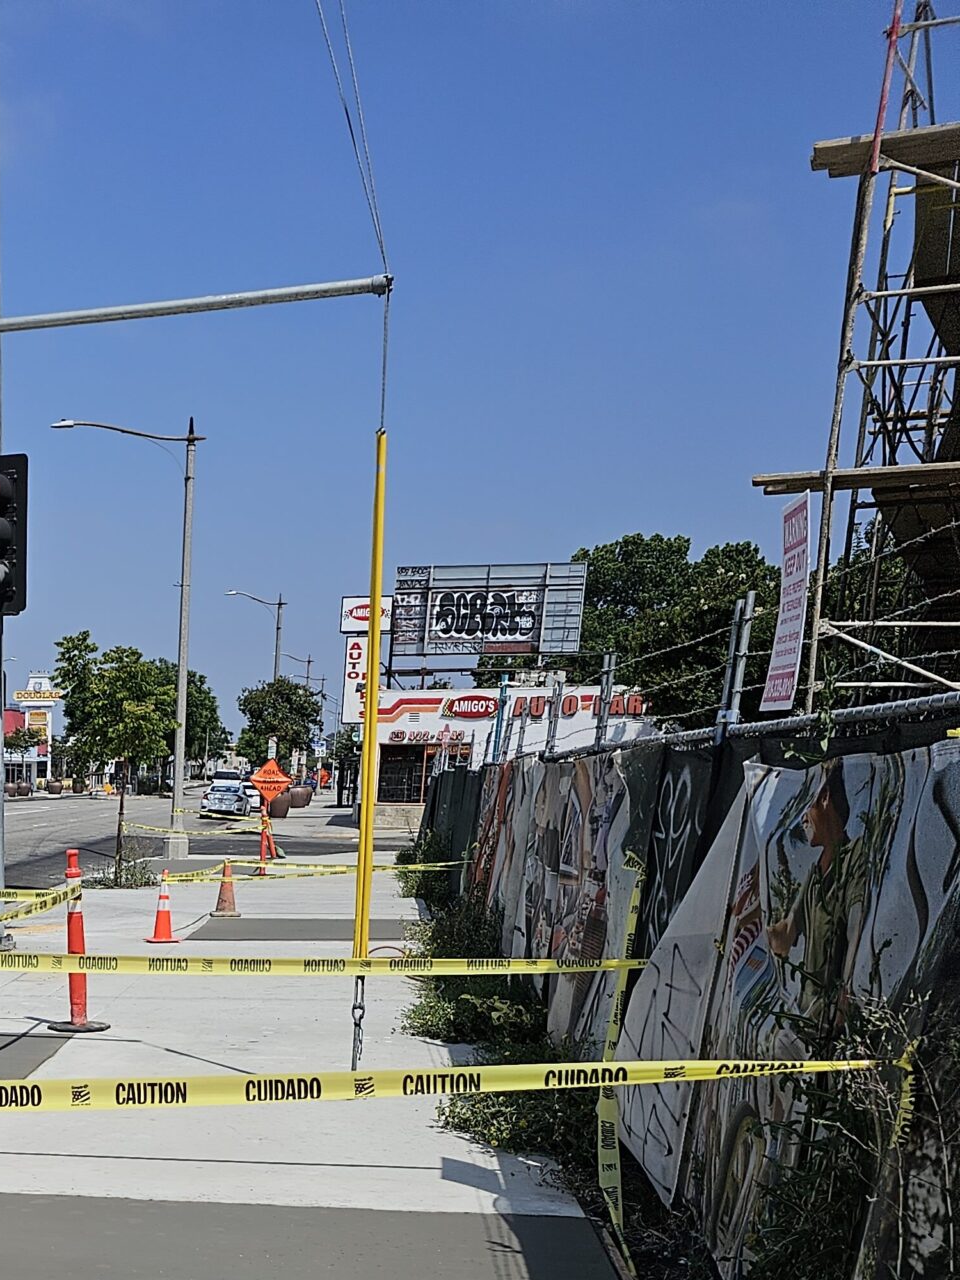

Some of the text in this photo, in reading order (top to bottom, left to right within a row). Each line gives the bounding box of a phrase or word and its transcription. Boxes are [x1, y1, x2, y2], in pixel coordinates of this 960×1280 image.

[347, 642, 363, 679] AUTO
[452, 700, 495, 713] AMIGO'S
[115, 1081, 187, 1105] CAUTION
[245, 1077, 322, 1102] CUIDADO
[402, 1072, 481, 1096] CAUTION
[544, 1066, 628, 1087] CUIDADO
